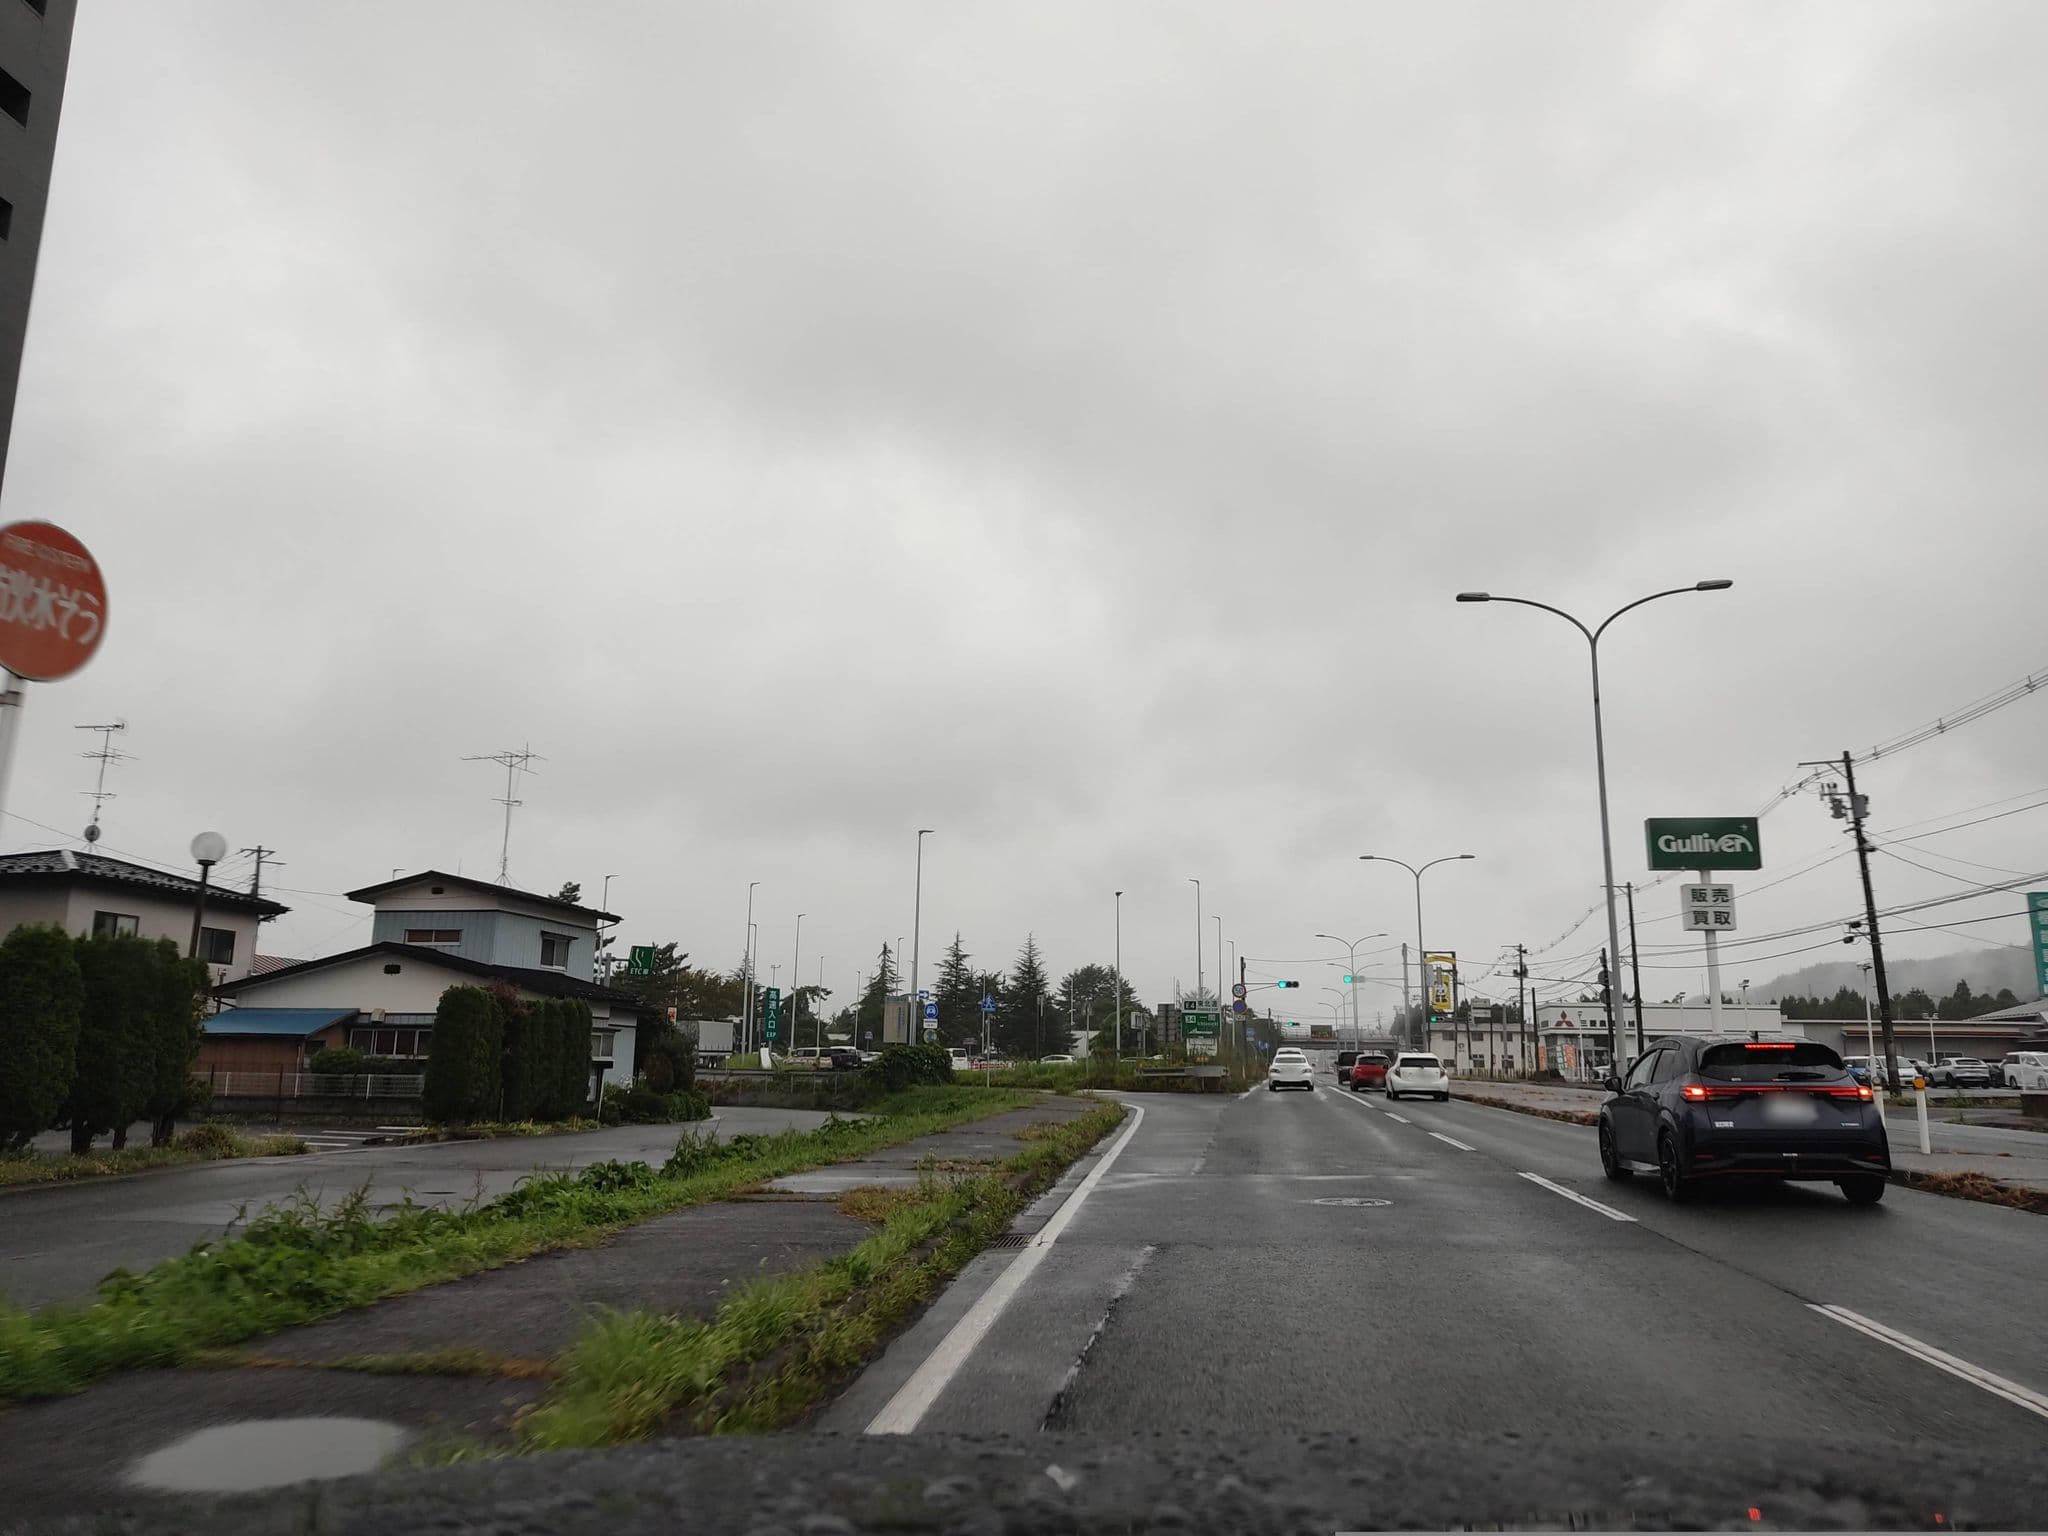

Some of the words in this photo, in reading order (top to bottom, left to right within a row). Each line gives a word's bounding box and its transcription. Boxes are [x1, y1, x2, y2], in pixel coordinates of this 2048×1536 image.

[1657, 832, 1754, 853] Gulliver
[1690, 888, 1730, 903] 販売
[1692, 910, 1731, 926] 買取
[630, 967, 643, 975] ETC
[768, 990, 777, 1029] 高速入口
